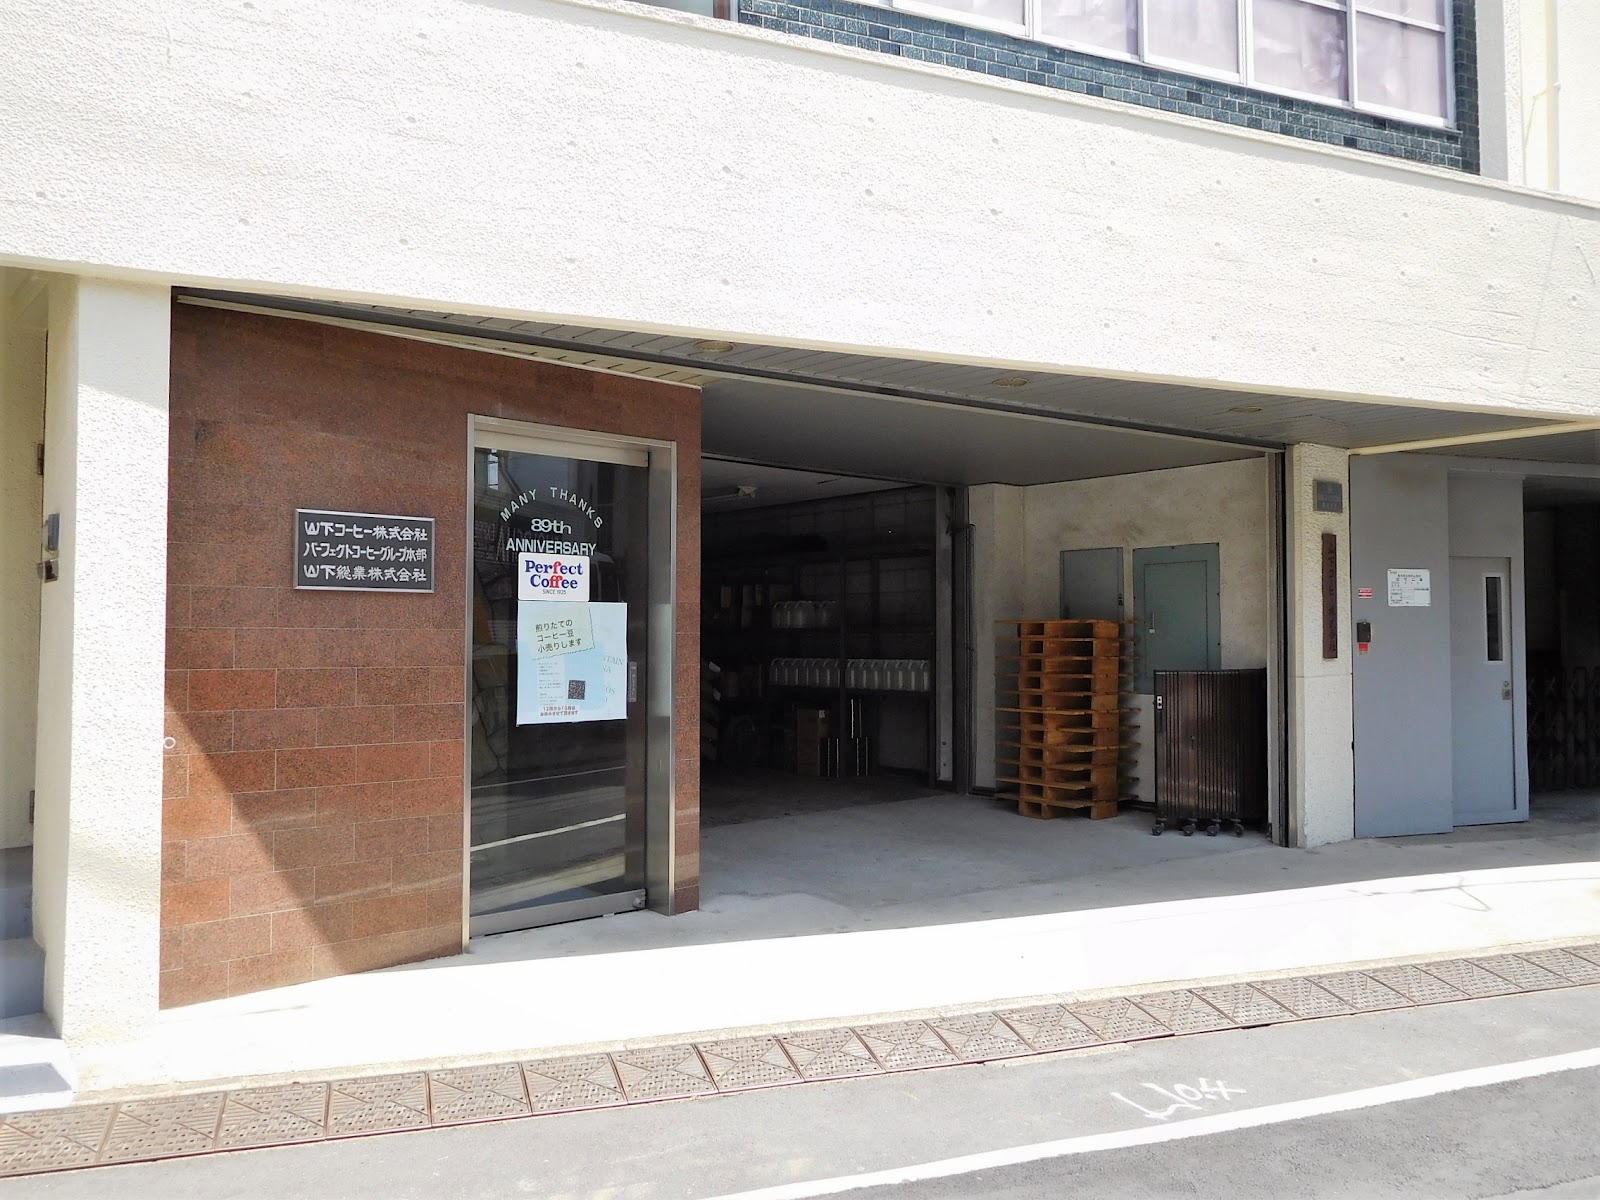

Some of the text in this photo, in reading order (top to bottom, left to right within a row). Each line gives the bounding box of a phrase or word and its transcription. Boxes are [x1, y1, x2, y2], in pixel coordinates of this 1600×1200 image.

[500, 487, 603, 529] MANY THANKS
[531, 518, 572, 535] 89th
[303, 542, 427, 562] パーフェクトコーヒーグループ本部
[506, 538, 597, 556] ANNIVERSARY
[525, 560, 583, 575] Perfect
[530, 574, 578, 589] Coffee
[535, 620, 573, 633] 煎りたての
[537, 629, 574, 642] コーヒー豆
[537, 638, 581, 653] 小売りします
